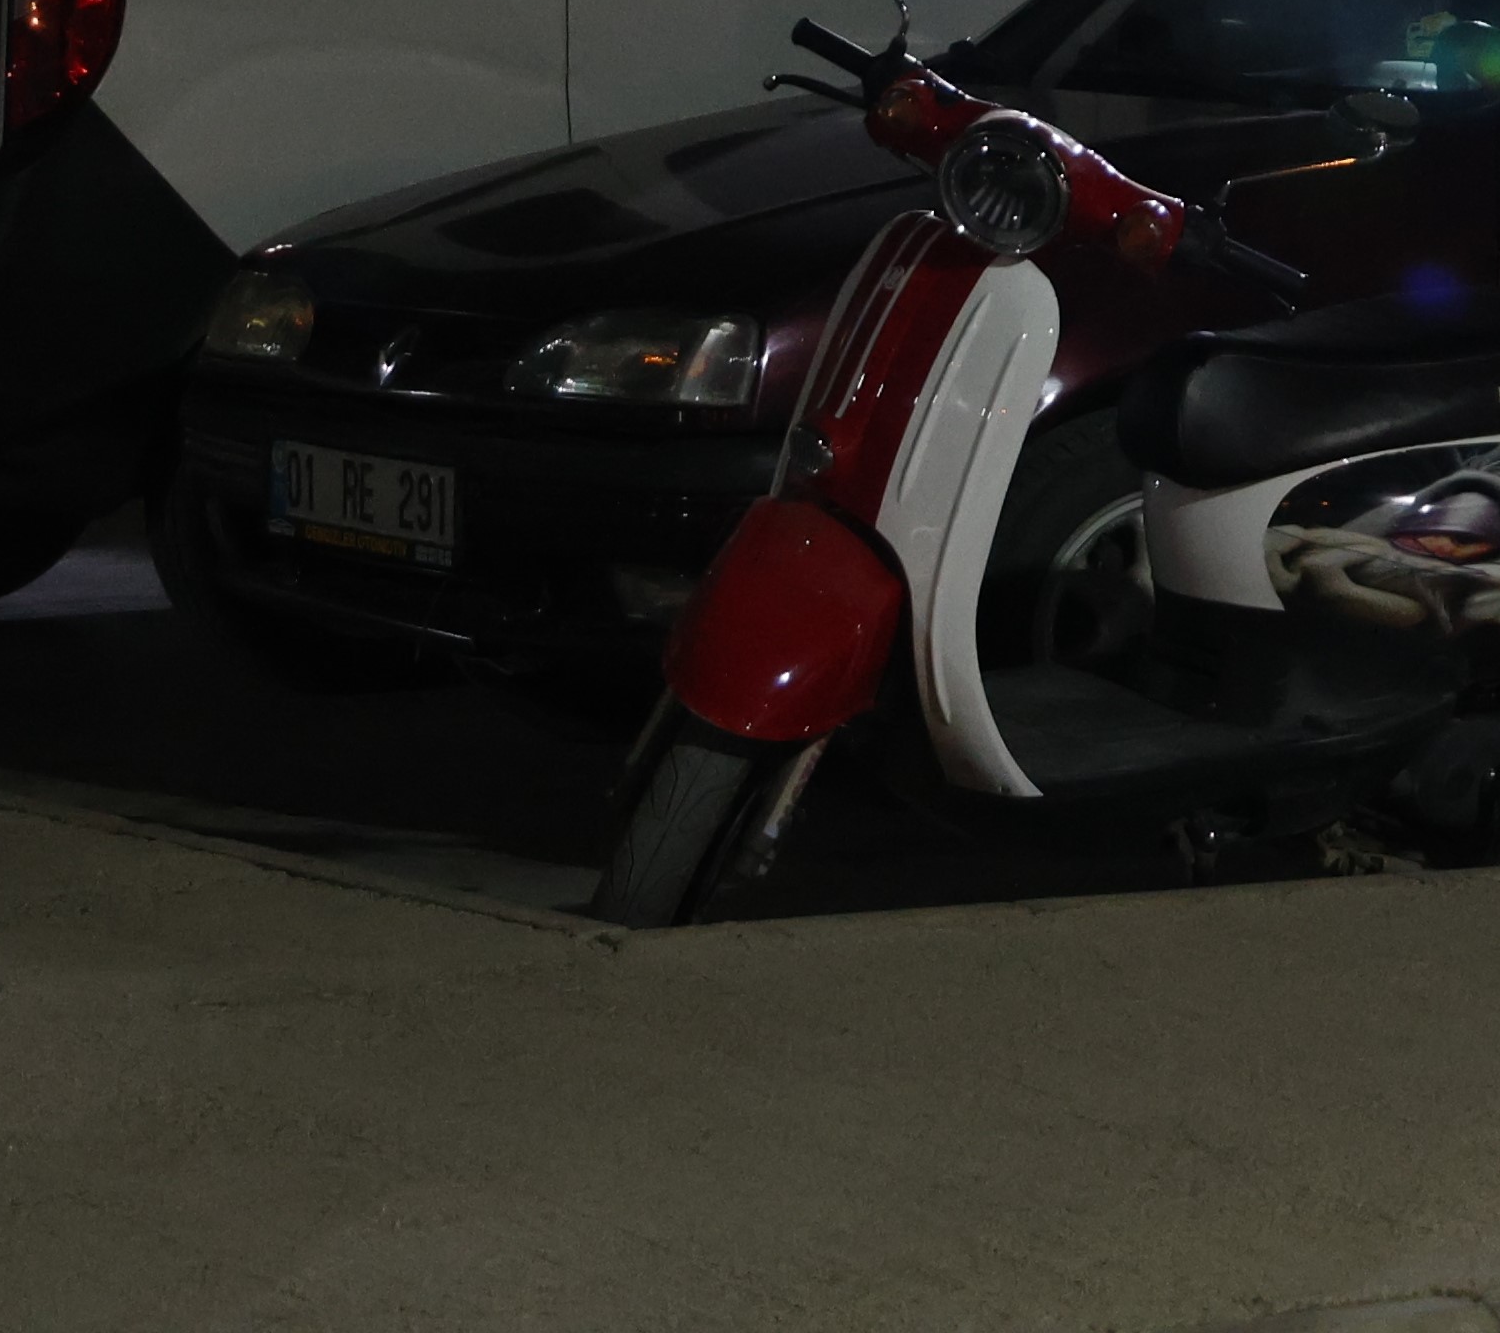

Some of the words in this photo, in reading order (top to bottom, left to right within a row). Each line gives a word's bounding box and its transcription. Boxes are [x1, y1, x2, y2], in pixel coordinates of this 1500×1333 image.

[288, 450, 314, 511] 01
[343, 459, 374, 523] RE
[399, 468, 446, 535] 291
